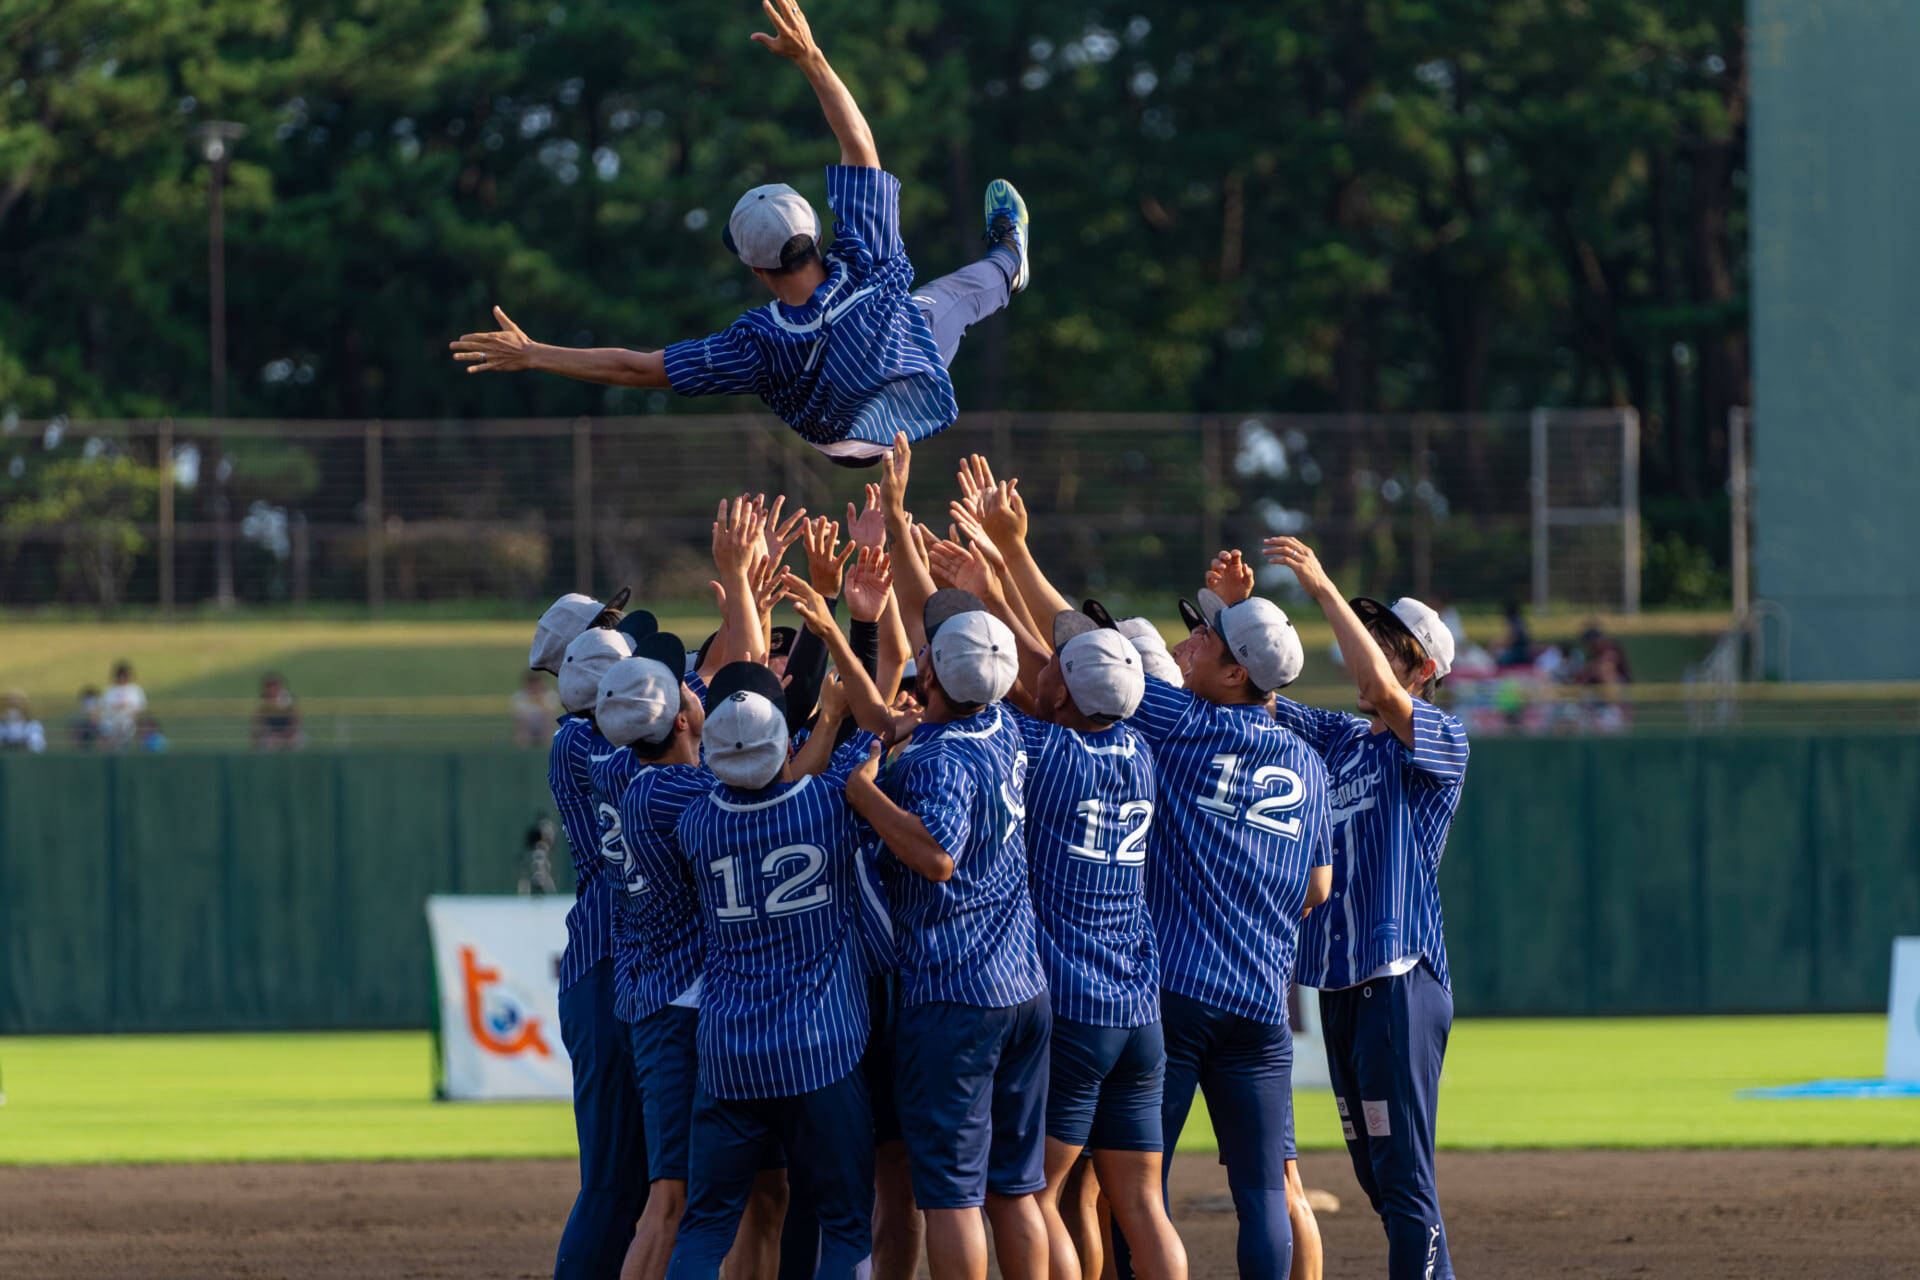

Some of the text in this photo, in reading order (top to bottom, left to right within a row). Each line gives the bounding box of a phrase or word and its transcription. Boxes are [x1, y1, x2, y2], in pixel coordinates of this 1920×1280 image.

[1067, 799, 1155, 866] 12
[1196, 754, 1307, 842] 12
[709, 844, 833, 922] 12
